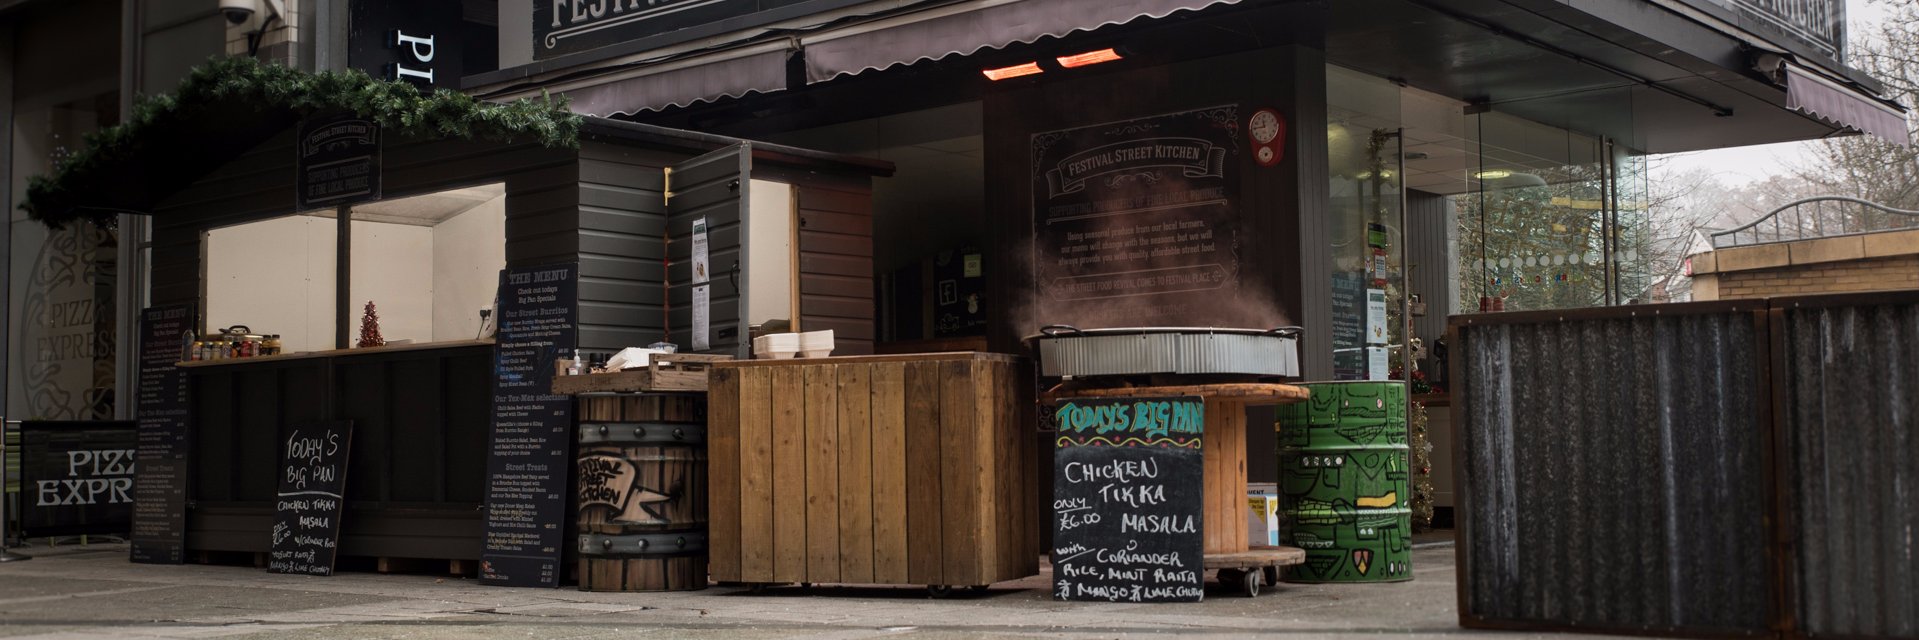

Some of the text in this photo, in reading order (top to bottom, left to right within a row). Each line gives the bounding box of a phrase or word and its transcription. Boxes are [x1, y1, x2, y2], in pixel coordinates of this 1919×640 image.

[1068, 144, 1200, 176] FESTIVAL STREET KITCHEN
[1067, 231, 1083, 242] Using
[1085, 228, 1109, 239] seasonal
[1111, 226, 1134, 238] produce
[1136, 225, 1150, 234] from
[1163, 221, 1177, 231] local
[1072, 244, 1088, 252] menu
[1090, 240, 1101, 251] will
[1124, 238, 1137, 248] with
[1139, 237, 1149, 246] the
[1177, 232, 1189, 242] but
[1200, 229, 1213, 240] will
[508, 269, 569, 285] THE MENU
[51, 298, 106, 328] PIZZA
[518, 308, 539, 317] Street
[540, 306, 569, 316] Burritos
[1056, 401, 1204, 440] TODAY'S BIG PAN
[287, 429, 339, 465] TODAY'S
[287, 464, 335, 489] BIG PAN
[505, 462, 549, 471] Street Treats
[1065, 457, 1158, 483] CHICKEN
[36, 477, 134, 506] EXPR
[1098, 483, 1166, 508] TIKKA
[278, 499, 336, 513] CHICKEN TIKKA
[299, 515, 329, 529] MASALA
[1060, 512, 1101, 531] £6.00
[1121, 513, 1196, 534] MASALA
[1096, 540, 1184, 567] CORIANDER
[1108, 568, 1149, 581] MINT
[1153, 568, 1198, 584] RAITA
[1077, 582, 1128, 602] MANGO
[1143, 587, 1175, 599] LIME
